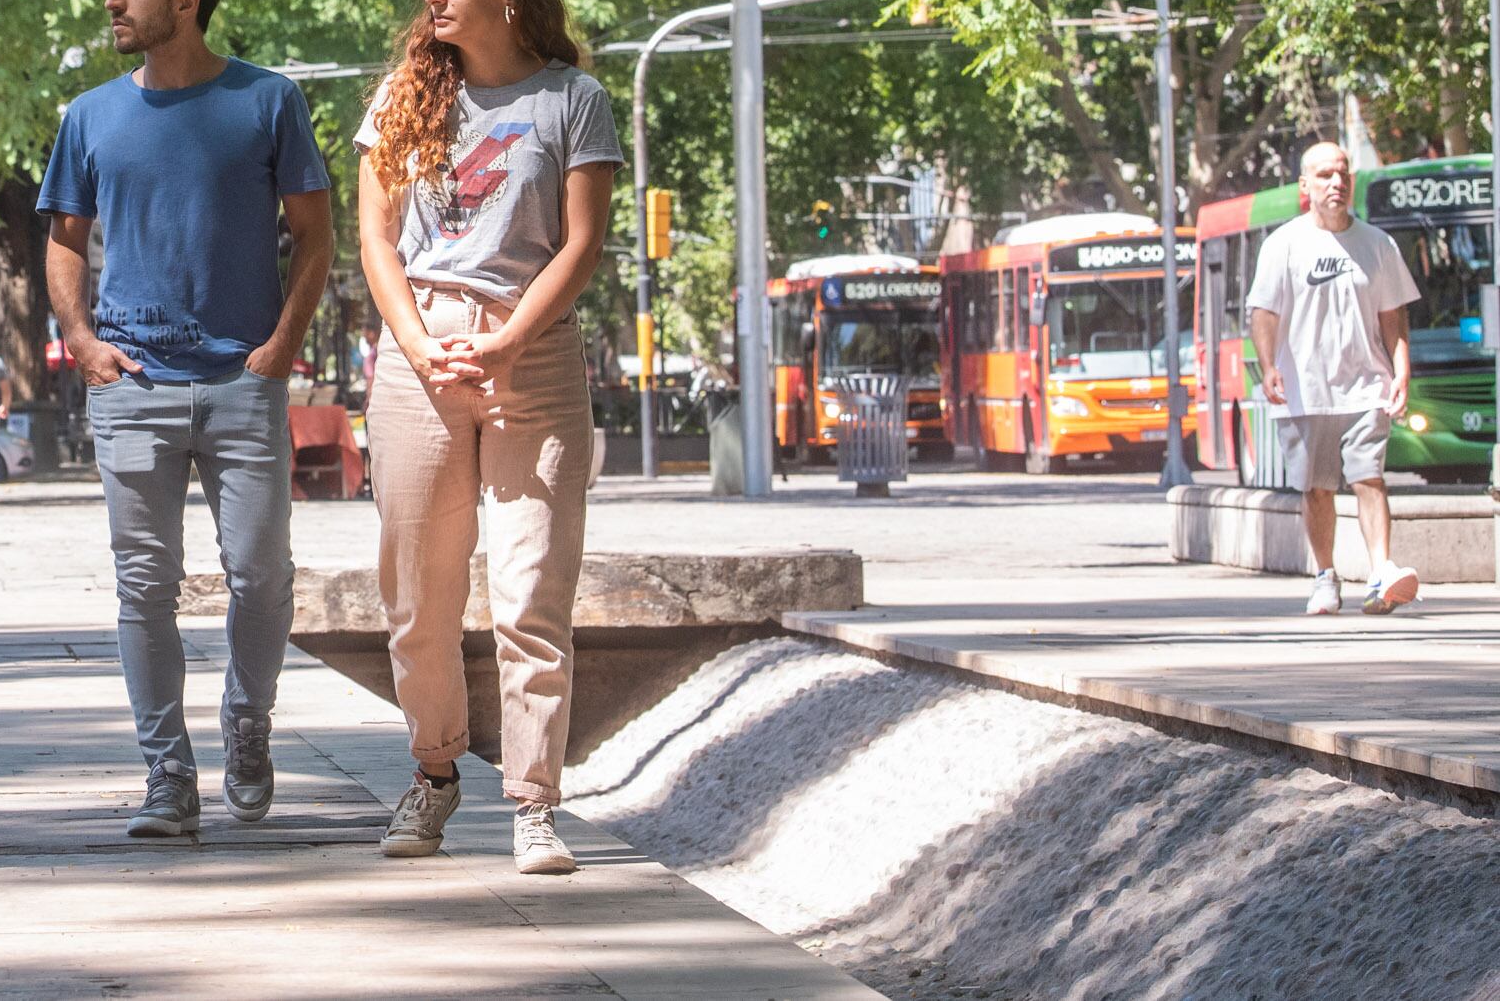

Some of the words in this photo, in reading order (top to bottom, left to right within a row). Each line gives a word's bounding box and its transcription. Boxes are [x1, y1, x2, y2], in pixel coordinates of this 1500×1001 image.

[1314, 257, 1350, 273] NIKE
[879, 282, 942, 297] LORENZO
[1462, 411, 1482, 432] 90
